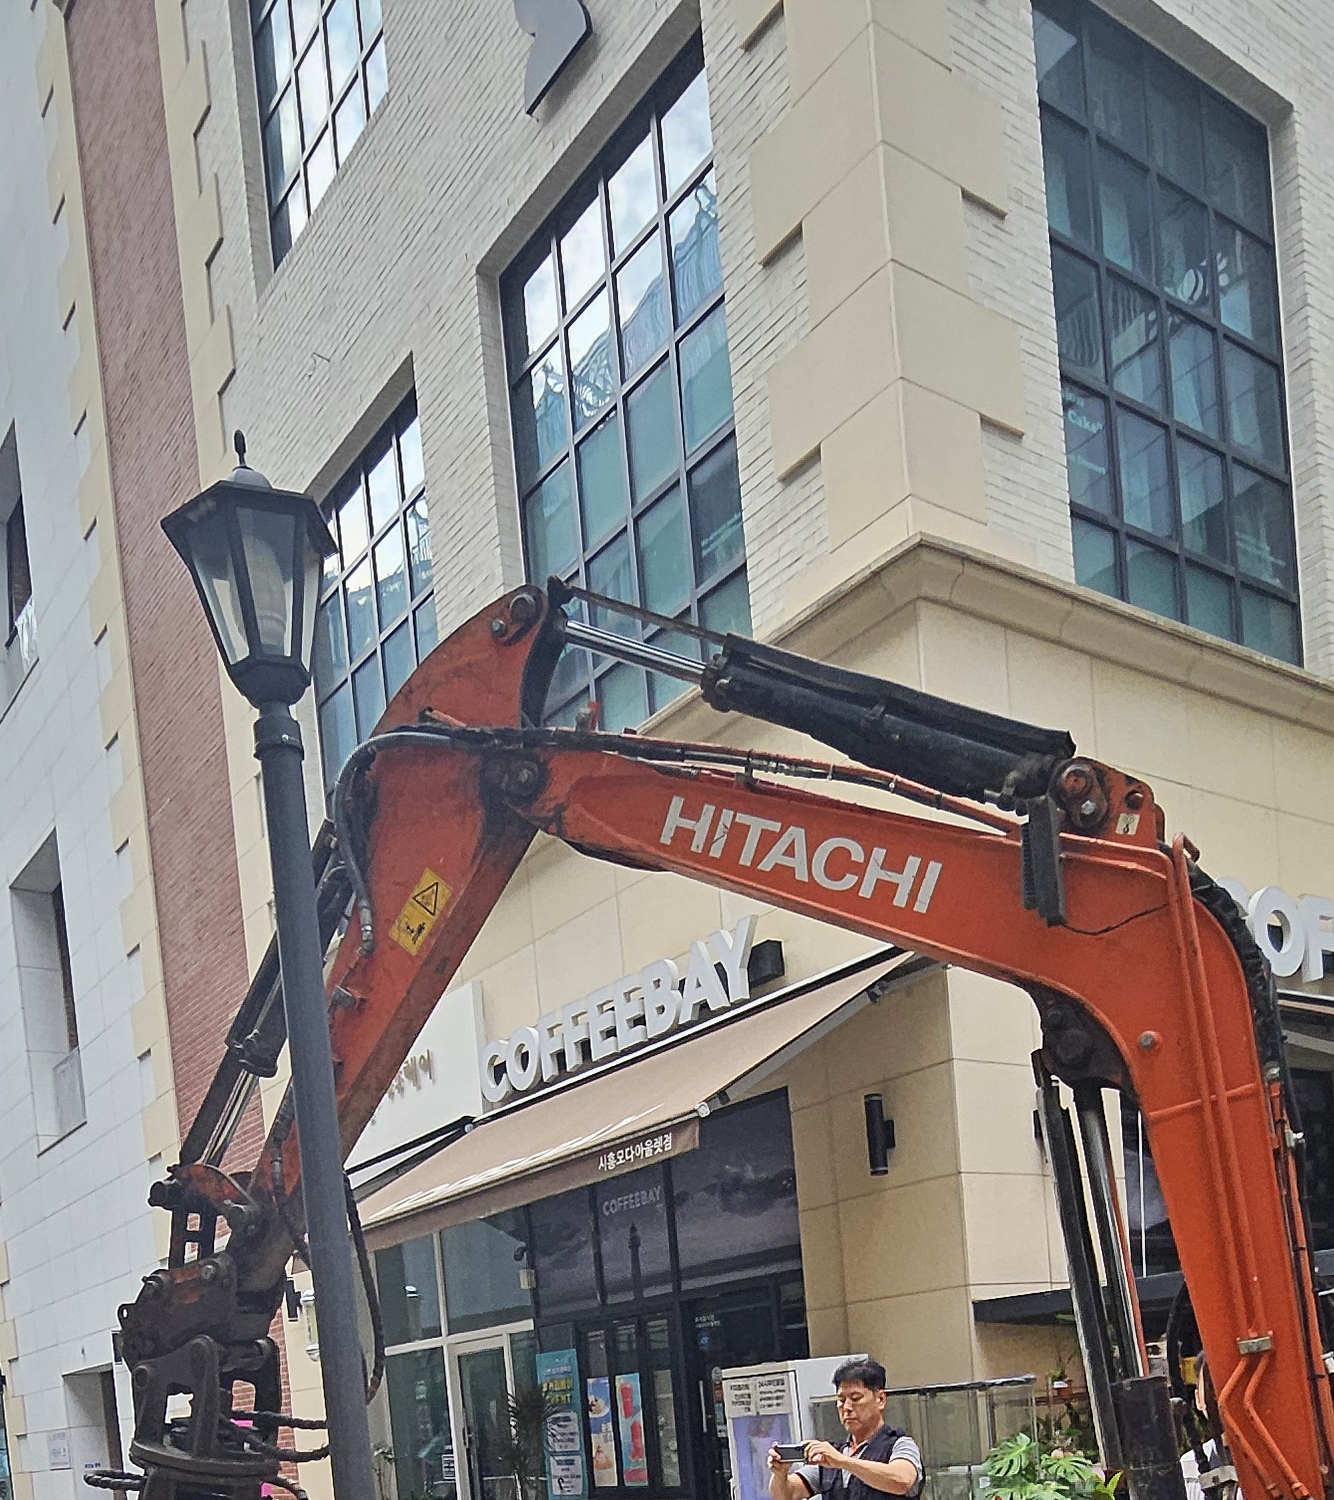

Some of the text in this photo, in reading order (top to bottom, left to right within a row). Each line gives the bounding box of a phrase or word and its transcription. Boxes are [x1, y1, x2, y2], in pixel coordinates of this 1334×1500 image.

[660, 795, 943, 914] HITACHI
[481, 914, 758, 1102] COFFEEBAY
[603, 1186, 661, 1216] COFFEEBAY
